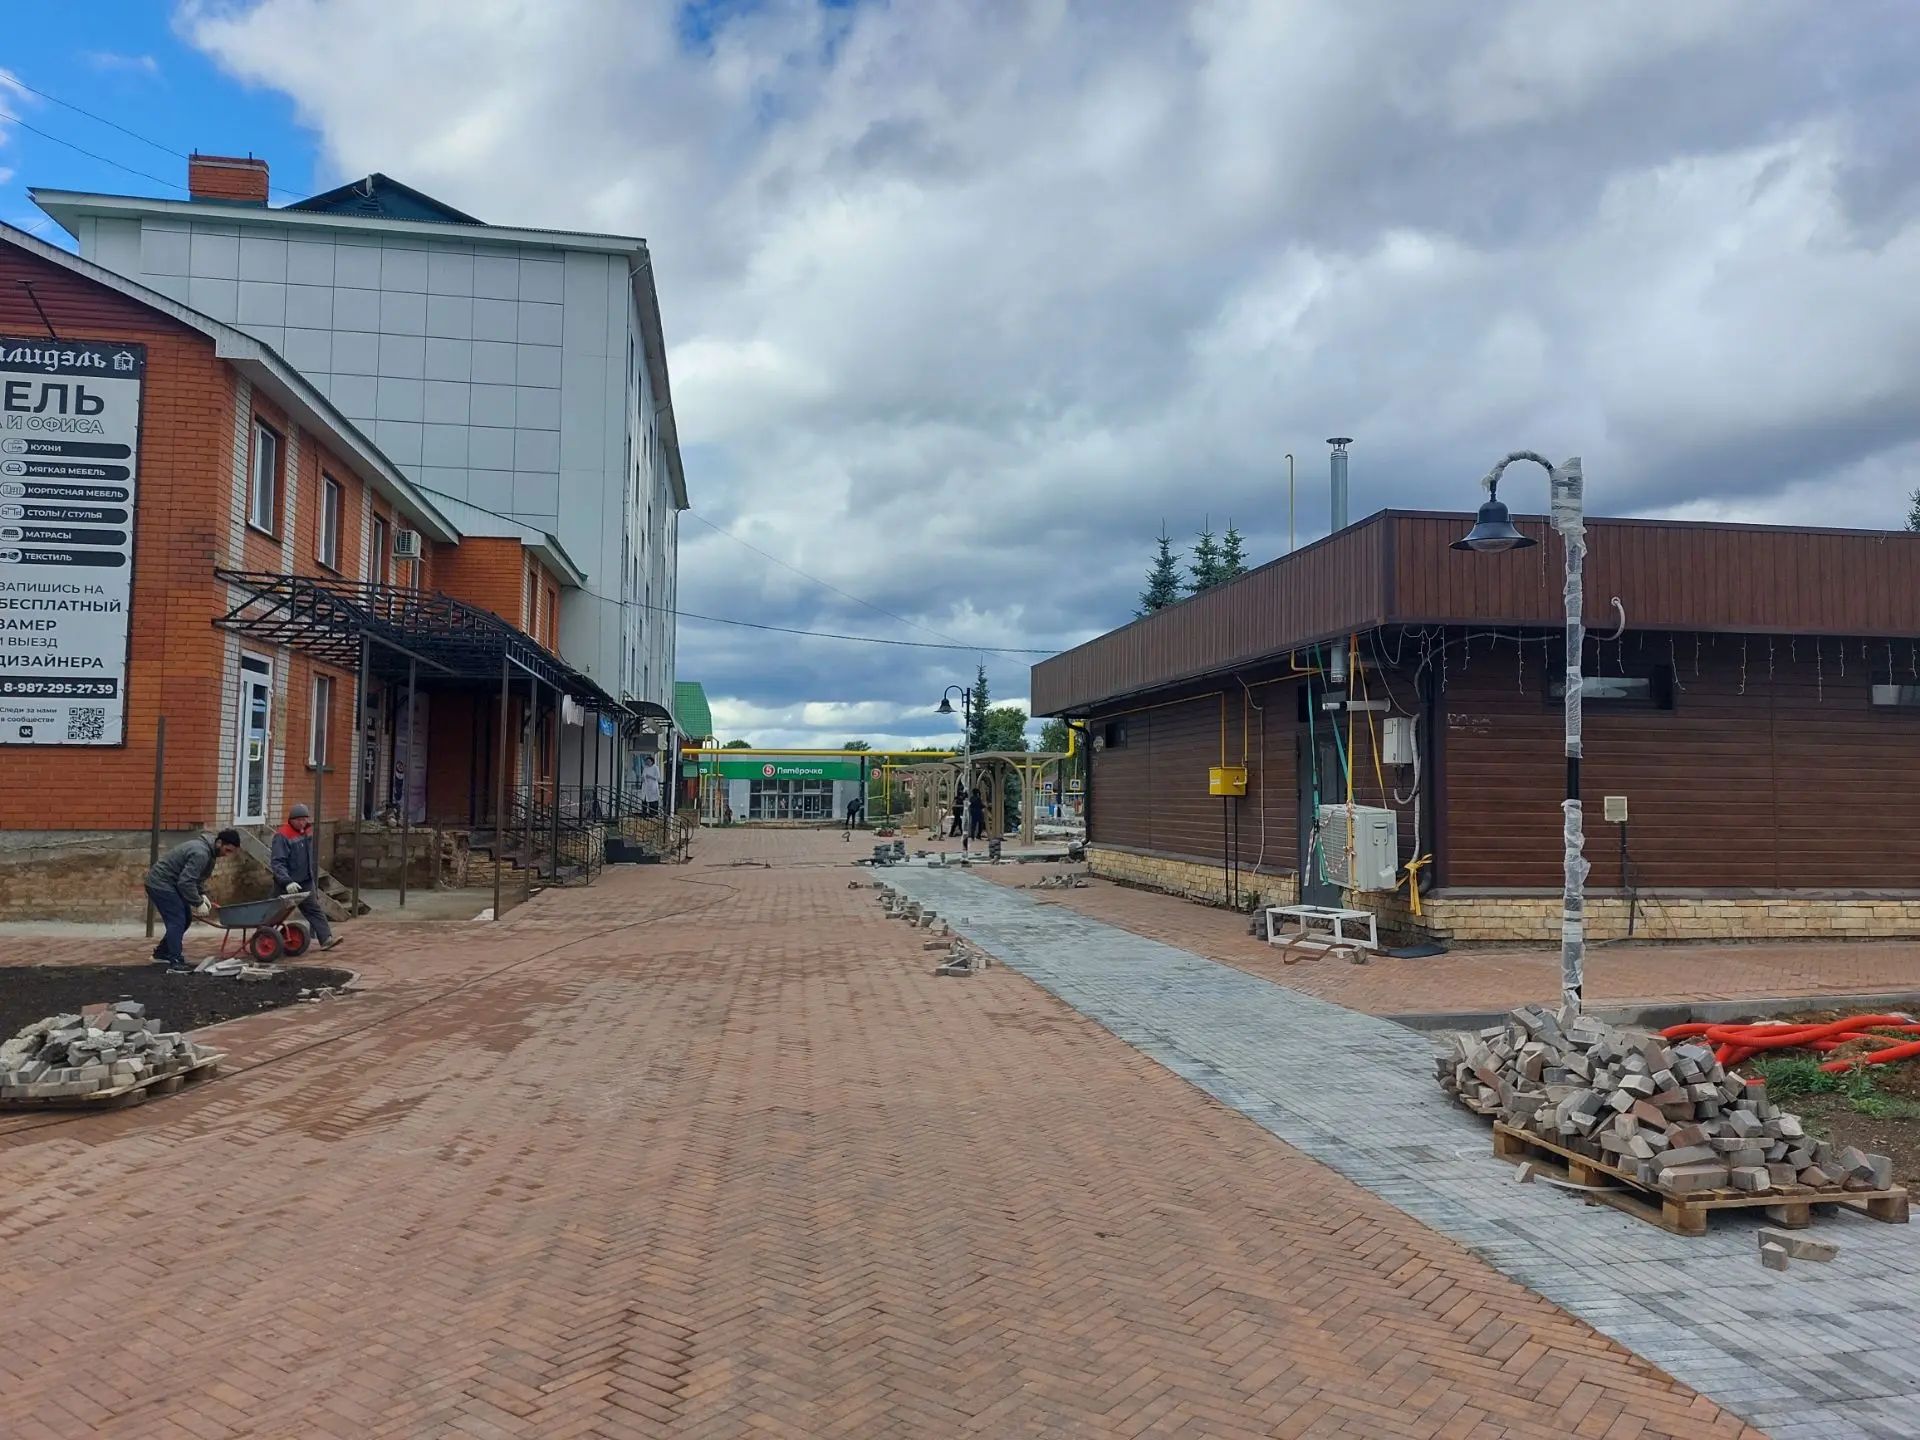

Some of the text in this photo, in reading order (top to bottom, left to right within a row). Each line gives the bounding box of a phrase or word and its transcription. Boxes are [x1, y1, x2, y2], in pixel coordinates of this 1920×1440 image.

[4, 380, 105, 416] ЕЛЬ
[7, 415, 104, 434] И ОФИСА
[30, 443, 62, 453] КУХНИ
[29, 465, 106, 476] МЯГКАЯ МЕБЕЛЬ
[28, 487, 124, 499] КОРПУСНАЯ МЕБЕЛЬ
[27, 509, 60, 518] СТОЛЫ
[67, 510, 103, 520] СТУЛЬЯ
[26, 530, 72, 540] МАТРАСЫ
[25, 552, 72, 562] ТЕКСТИЛЬ
[0, 581, 104, 595] ЗАПИШИСЬ НА
[0, 598, 121, 613] БЕСПЛАТНЫЙ
[8, 637, 58, 649] ВЫЕЗД
[3, 682, 114, 695] 8-987-295-27-39
